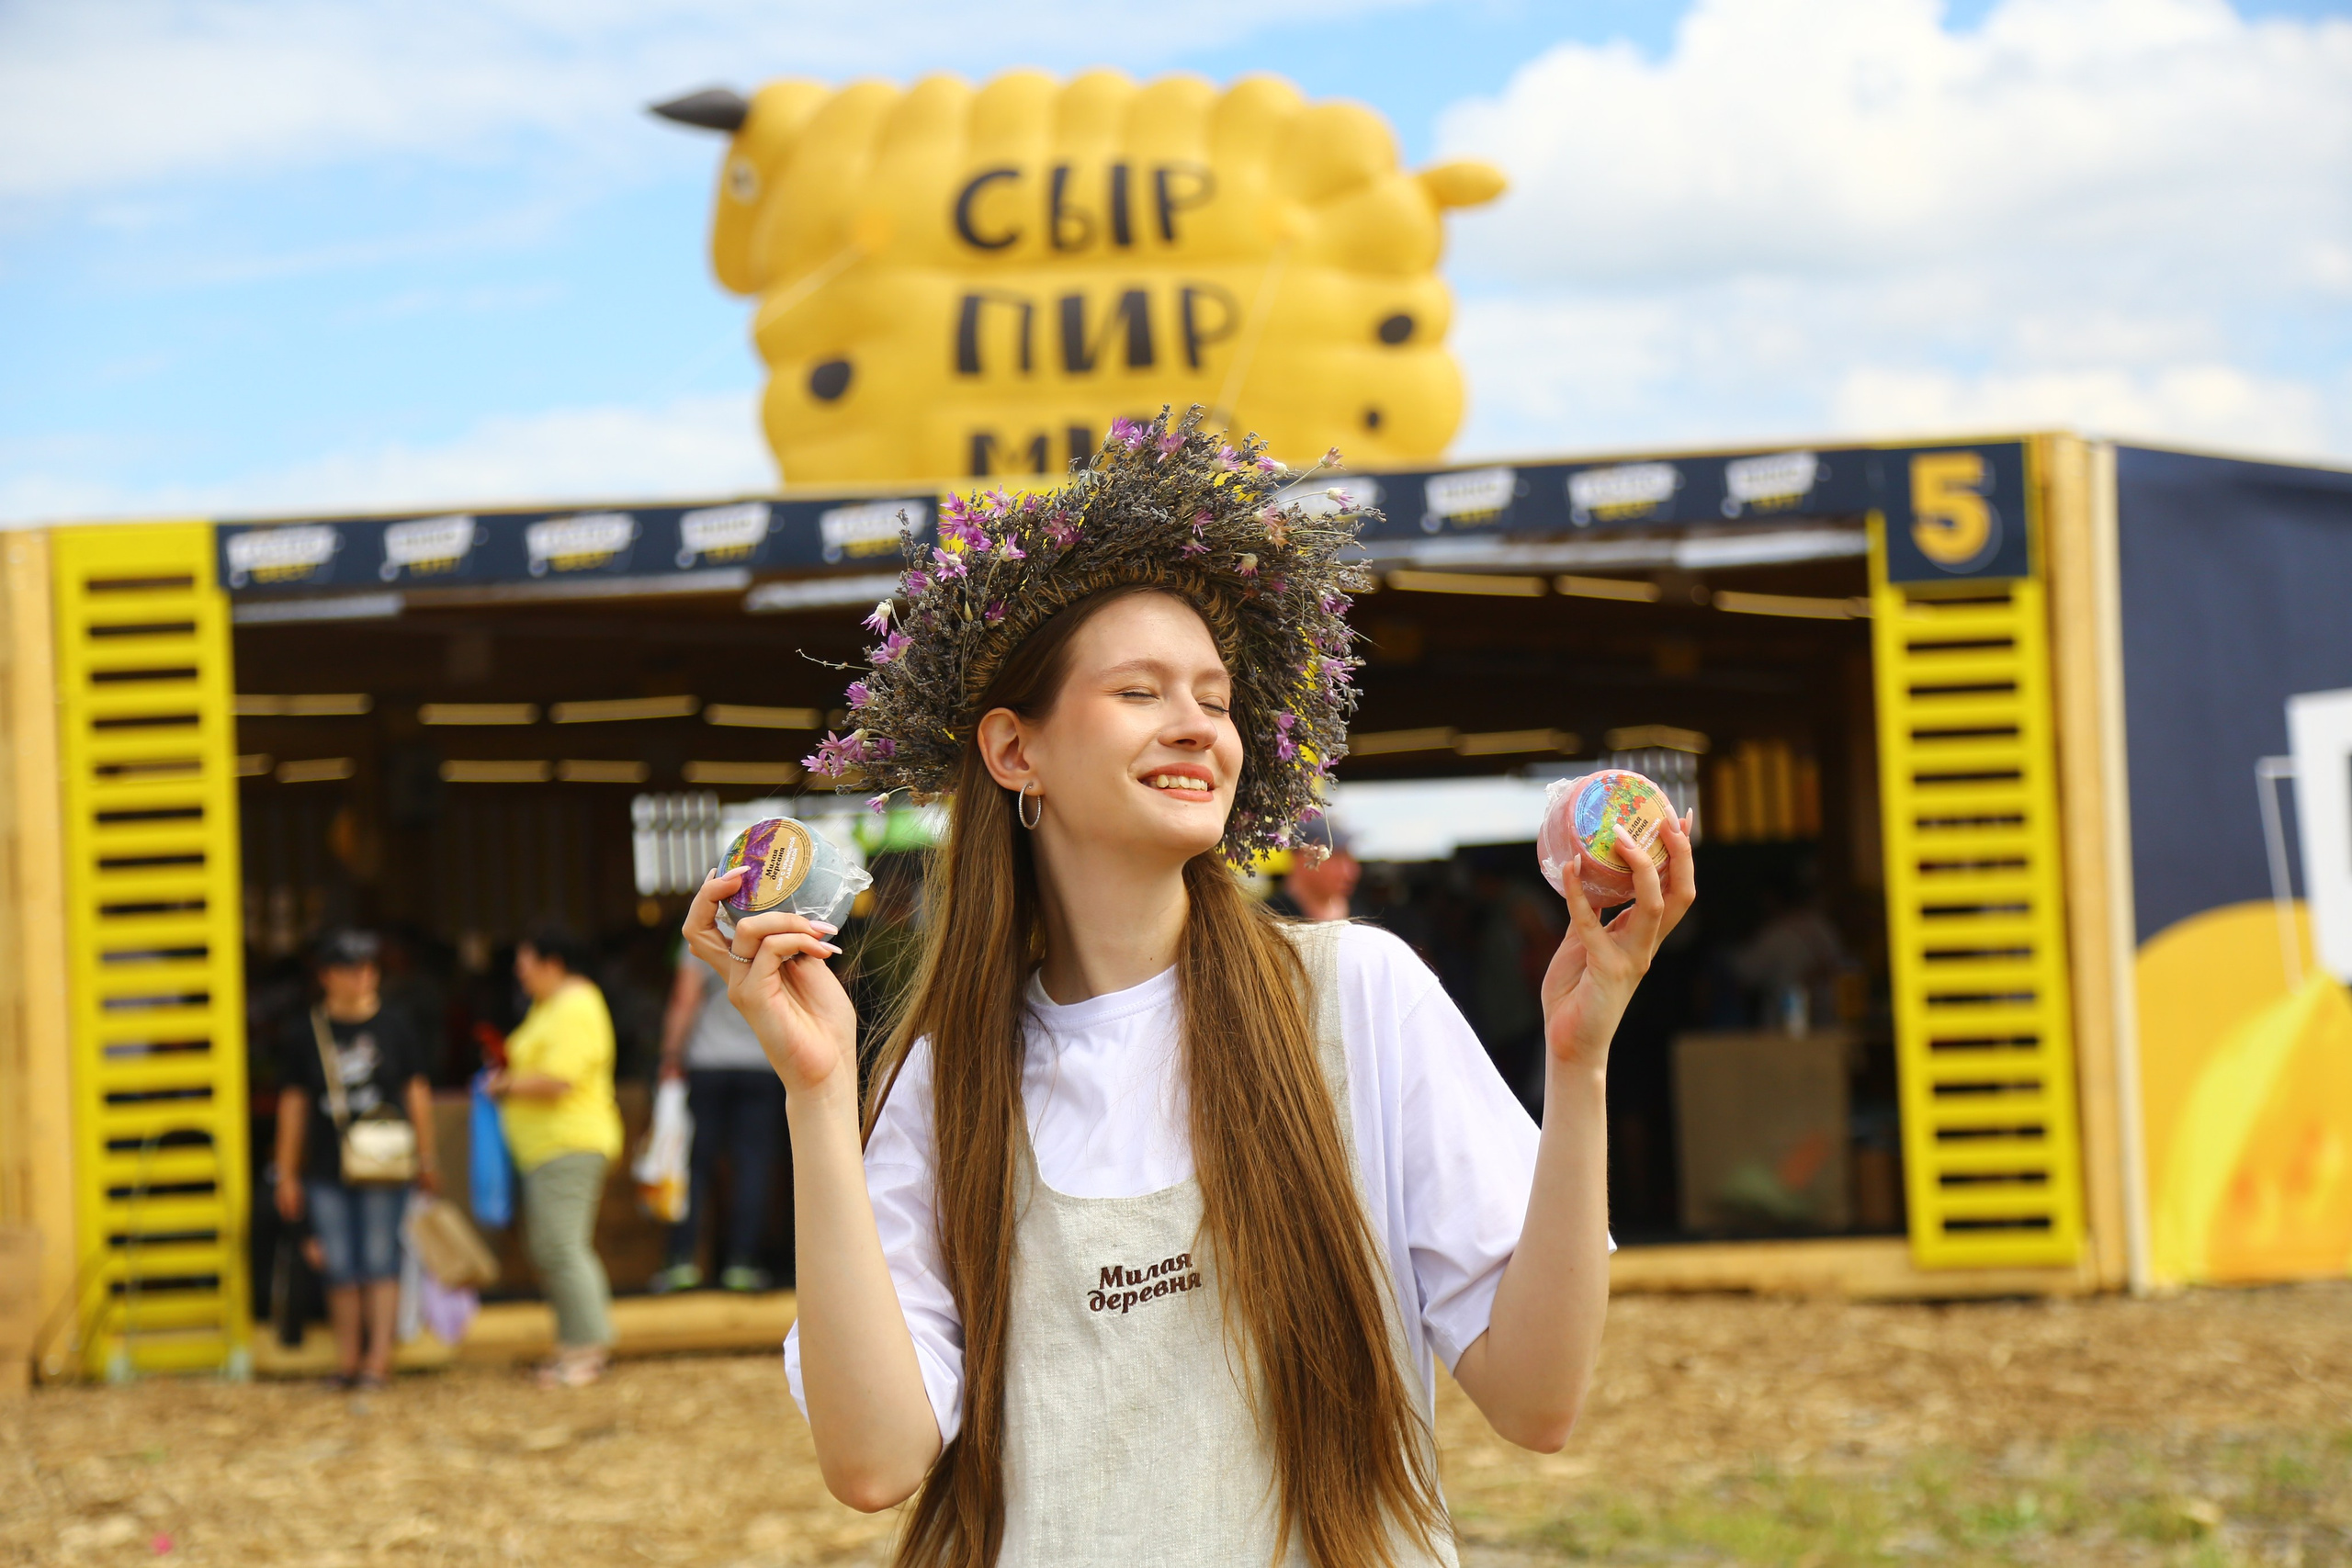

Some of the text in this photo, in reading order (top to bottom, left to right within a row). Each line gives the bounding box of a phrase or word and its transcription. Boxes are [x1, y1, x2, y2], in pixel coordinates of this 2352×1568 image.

[951, 159, 1216, 254] СЫР
[956, 283, 1241, 378] ПИР
[1909, 450, 1992, 565] 5
[1628, 817, 1642, 834] илая
[1632, 819, 1648, 841] ревня
[1643, 830, 1660, 852] ОМАТАМИ
[765, 850, 778, 876] Милая
[770, 848, 785, 880] деревня
[1099, 1253, 1193, 1290] Милая
[1087, 1272, 1202, 1314] деревня
